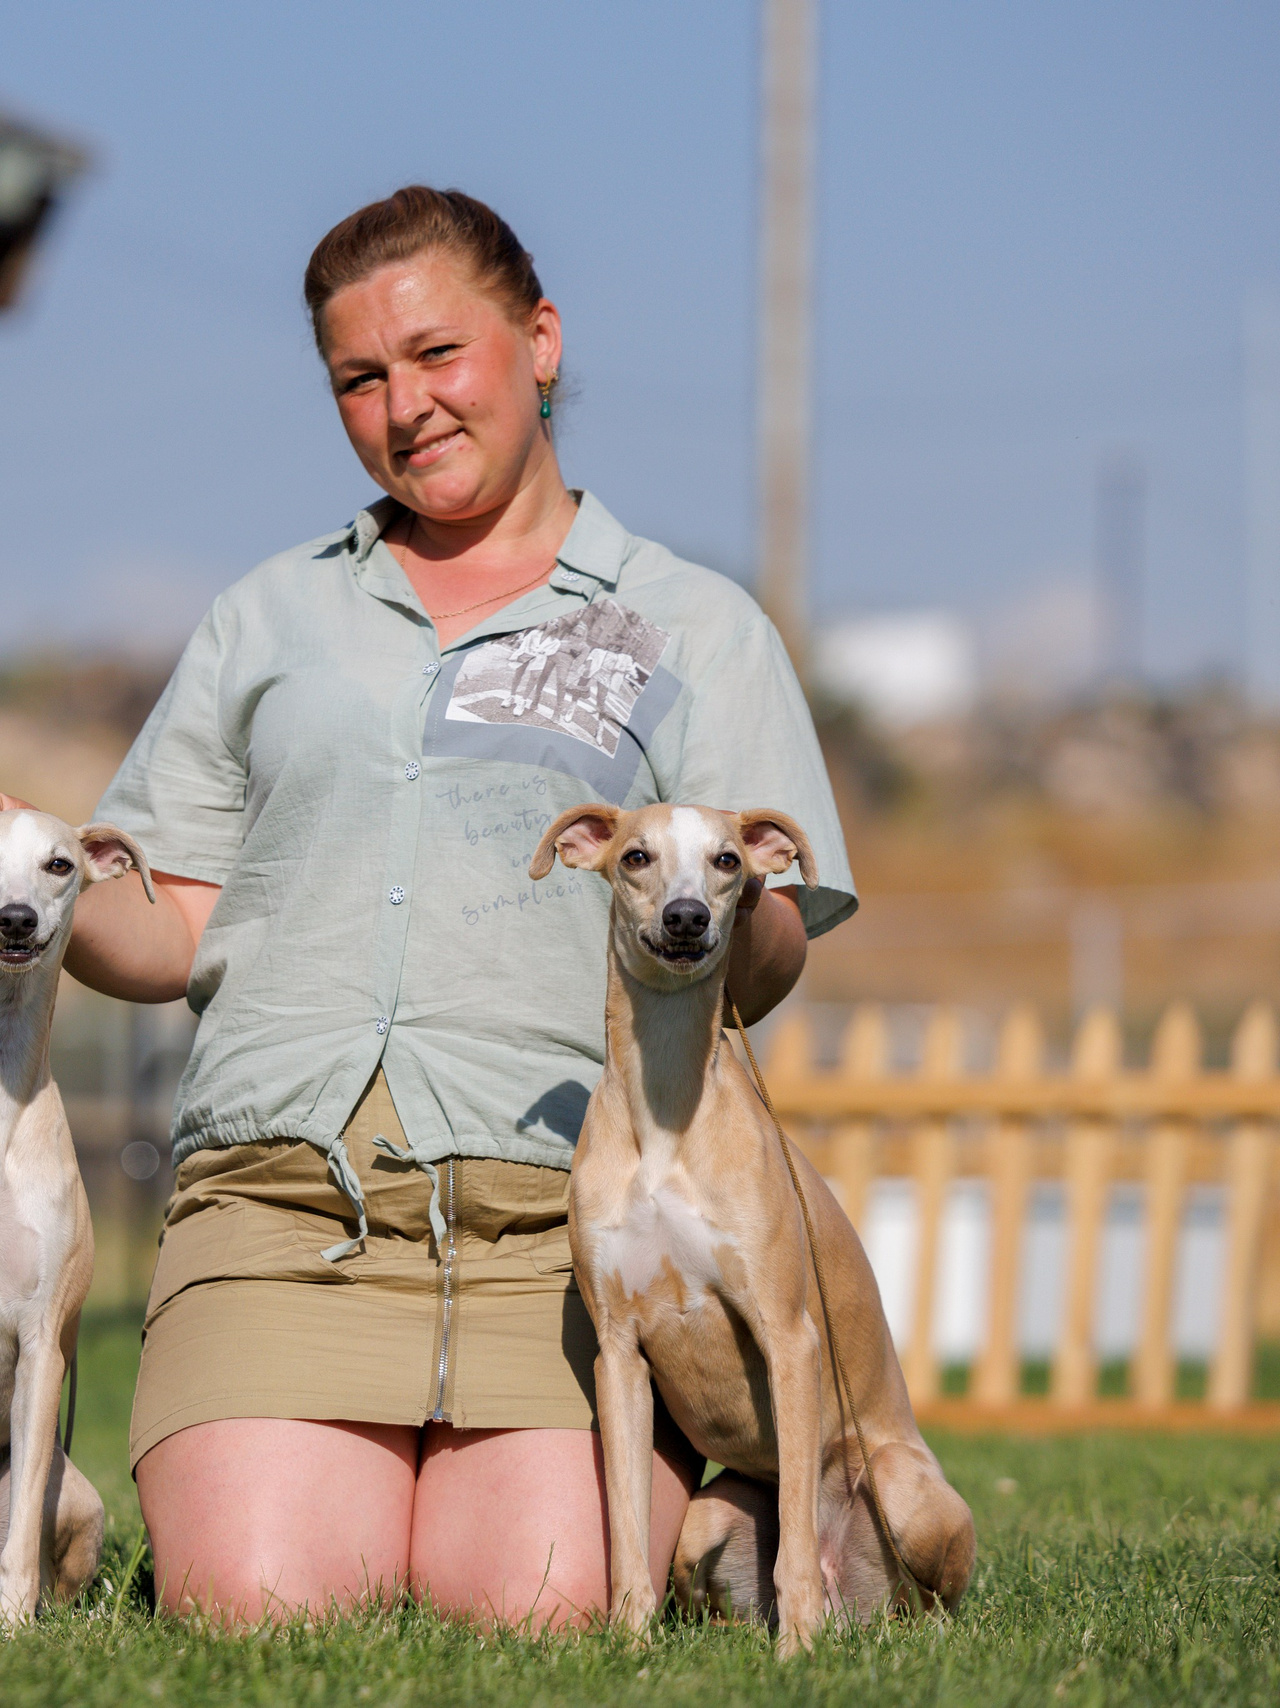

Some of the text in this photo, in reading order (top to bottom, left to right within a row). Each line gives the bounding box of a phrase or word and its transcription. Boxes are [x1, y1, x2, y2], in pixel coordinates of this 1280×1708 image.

[435, 775, 547, 809] there is
[464, 808, 552, 846] beauty
